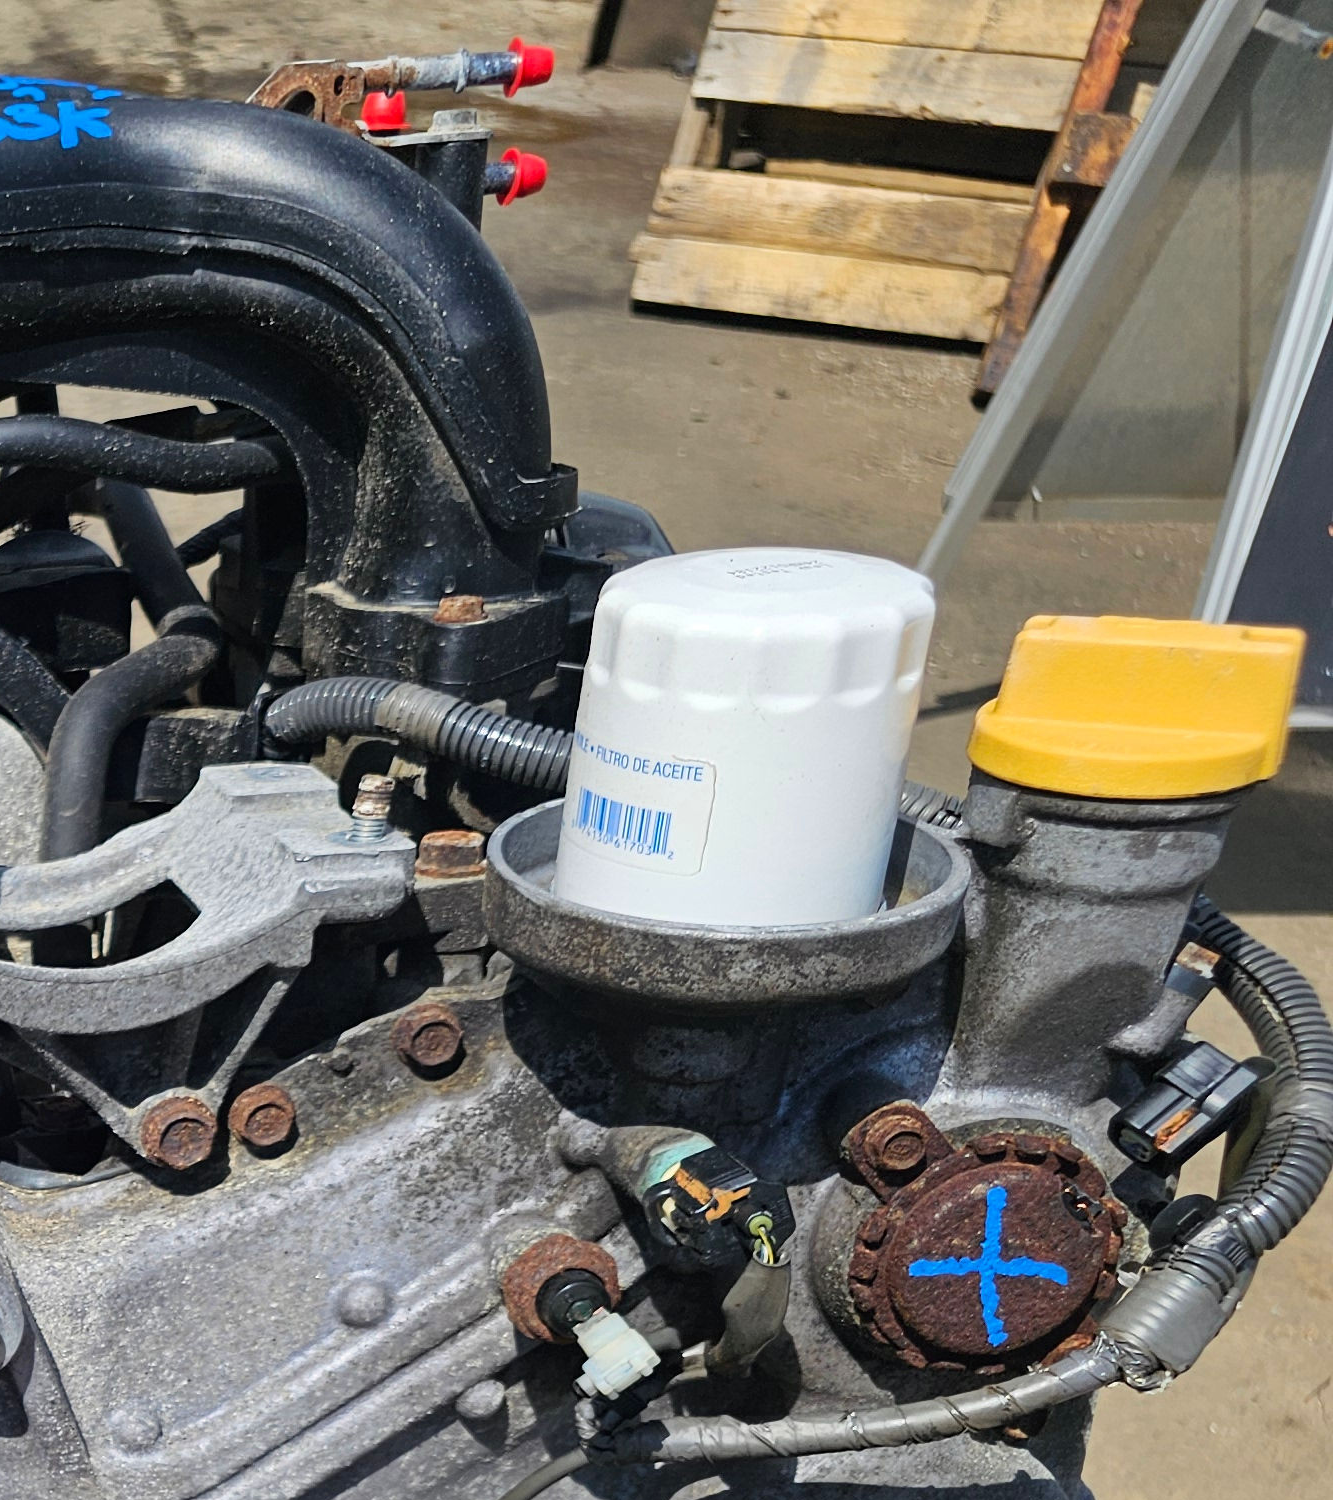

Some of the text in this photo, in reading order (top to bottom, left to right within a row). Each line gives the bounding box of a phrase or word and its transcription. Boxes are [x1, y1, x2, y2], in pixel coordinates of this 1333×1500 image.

[595, 744, 630, 769] FILTRO
[632, 756, 650, 775] DE
[652, 761, 705, 782] ACEITE
